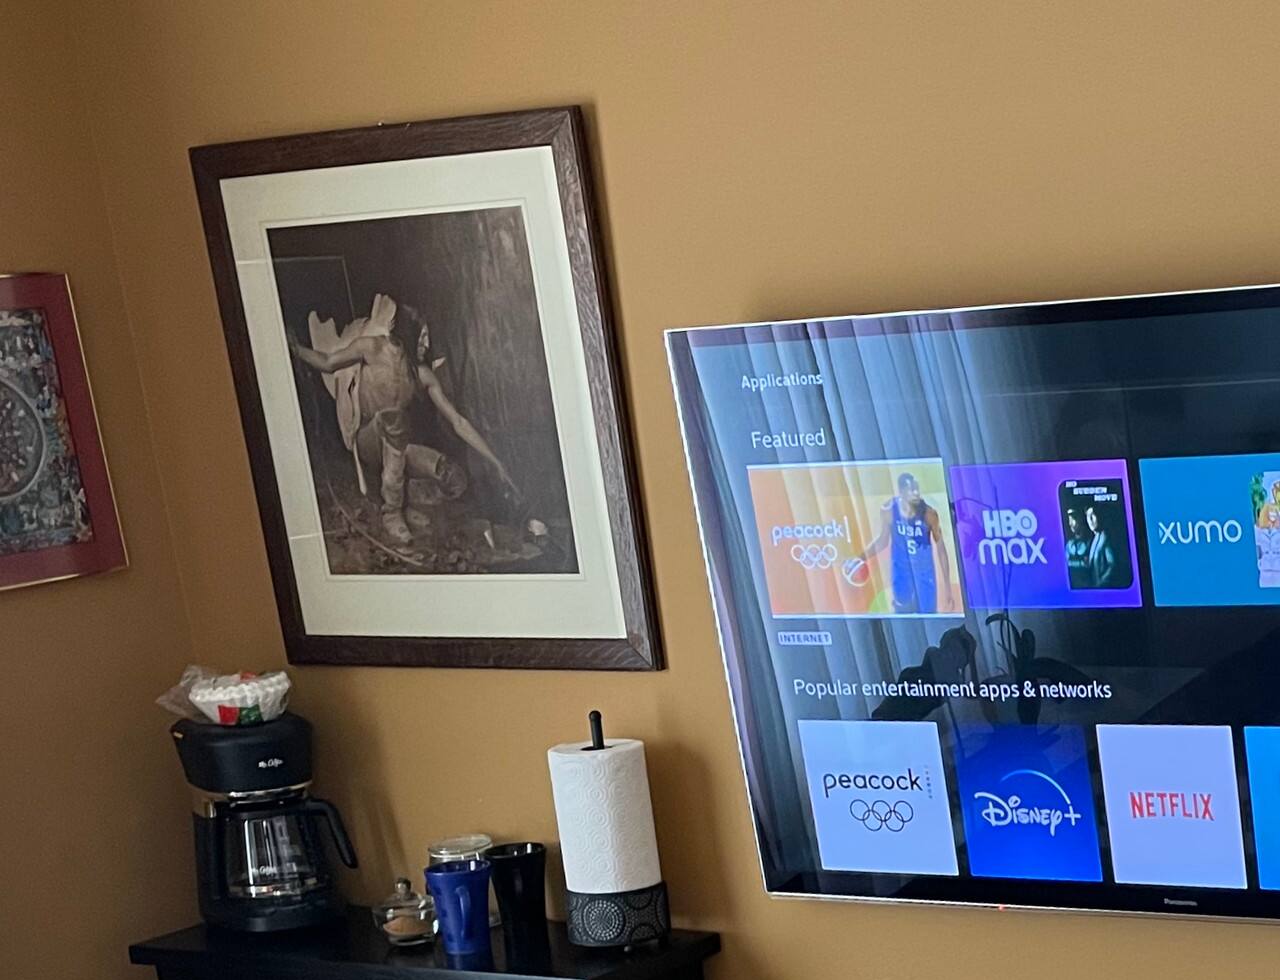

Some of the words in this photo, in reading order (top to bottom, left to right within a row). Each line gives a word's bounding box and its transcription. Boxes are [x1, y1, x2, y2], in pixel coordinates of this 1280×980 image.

[741, 372, 824, 392] Applications
[751, 427, 826, 449] Featured
[772, 519, 845, 547] peacock
[897, 524, 923, 537] USA
[982, 509, 1038, 538] HBO
[1158, 519, 1243, 544] xumo
[907, 540, 917, 555] 5
[978, 537, 1048, 565] max
[780, 632, 831, 644] INTERNET
[793, 679, 857, 700] Popular
[862, 679, 977, 697] entertainment
[979, 683, 1020, 702] apps
[1023, 680, 1036, 698] &
[1040, 680, 1112, 698] networks
[823, 767, 923, 798] peacock
[1130, 791, 1216, 821] NETFLIX
